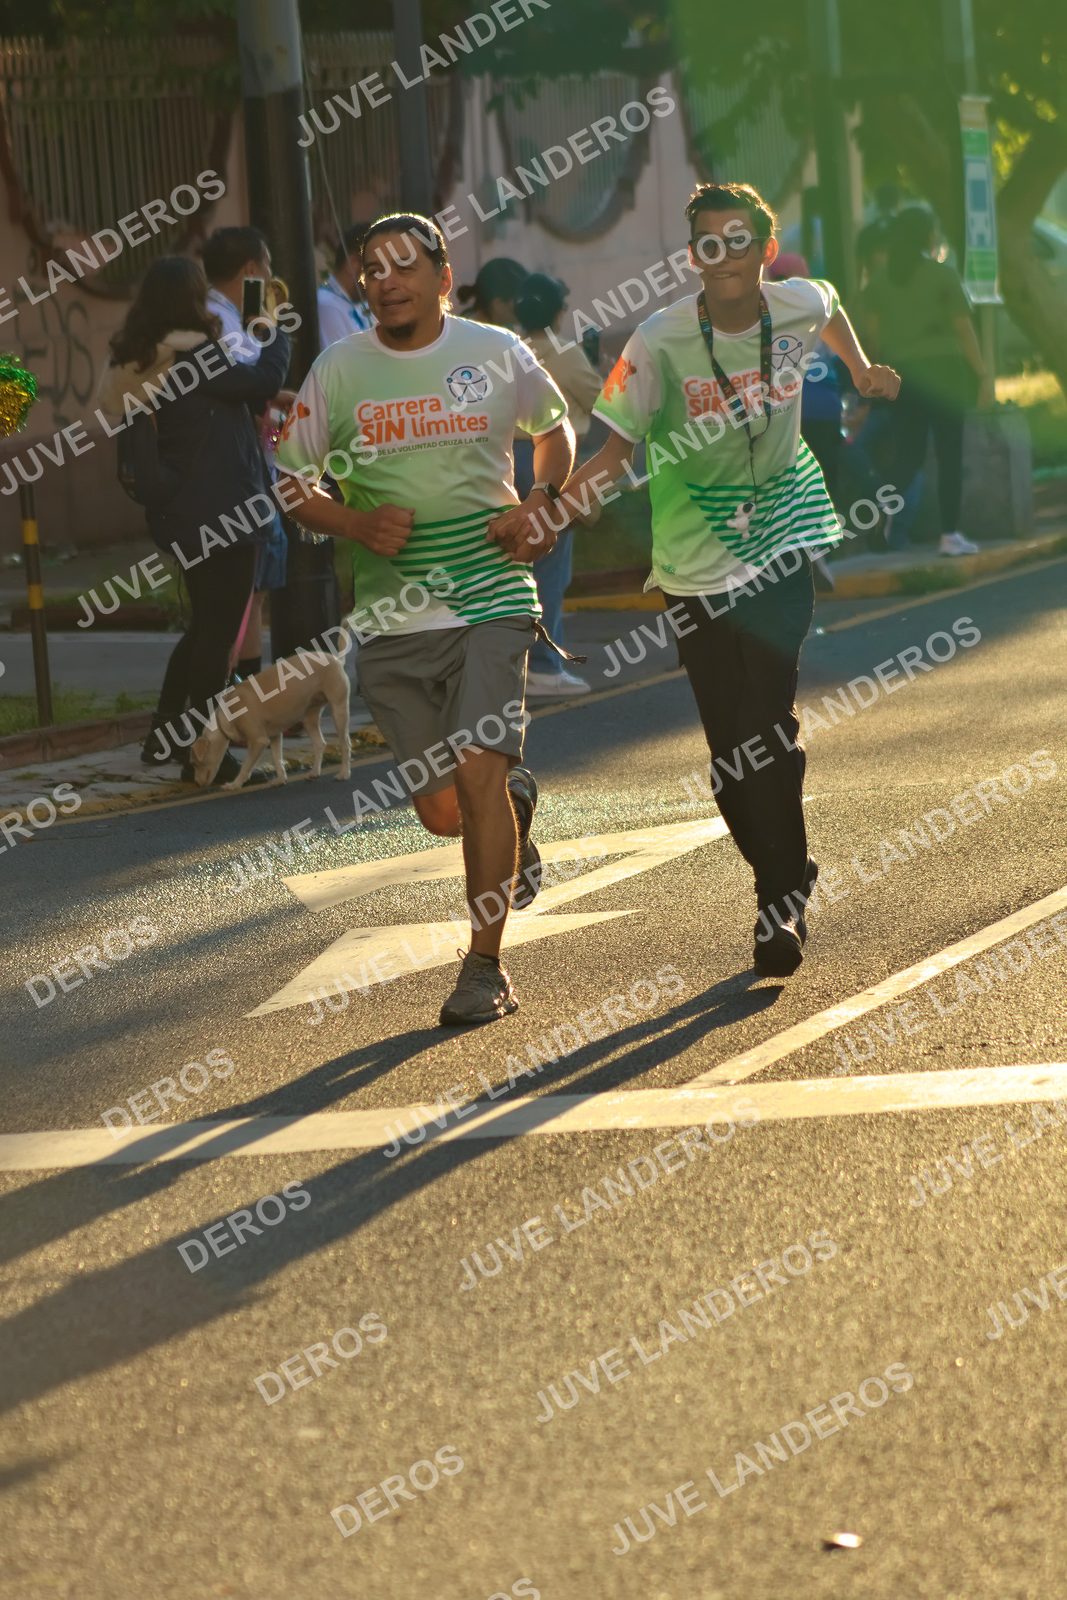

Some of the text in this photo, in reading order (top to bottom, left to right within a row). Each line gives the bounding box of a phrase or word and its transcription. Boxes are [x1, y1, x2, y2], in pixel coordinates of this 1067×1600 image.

[684, 371, 761, 397] Carera
[358, 398, 442, 424] Carrera
[362, 414, 488, 447] SIN límites
[398, 441, 438, 453] VOLUNTAD
[439, 438, 463, 447] CRUZA
